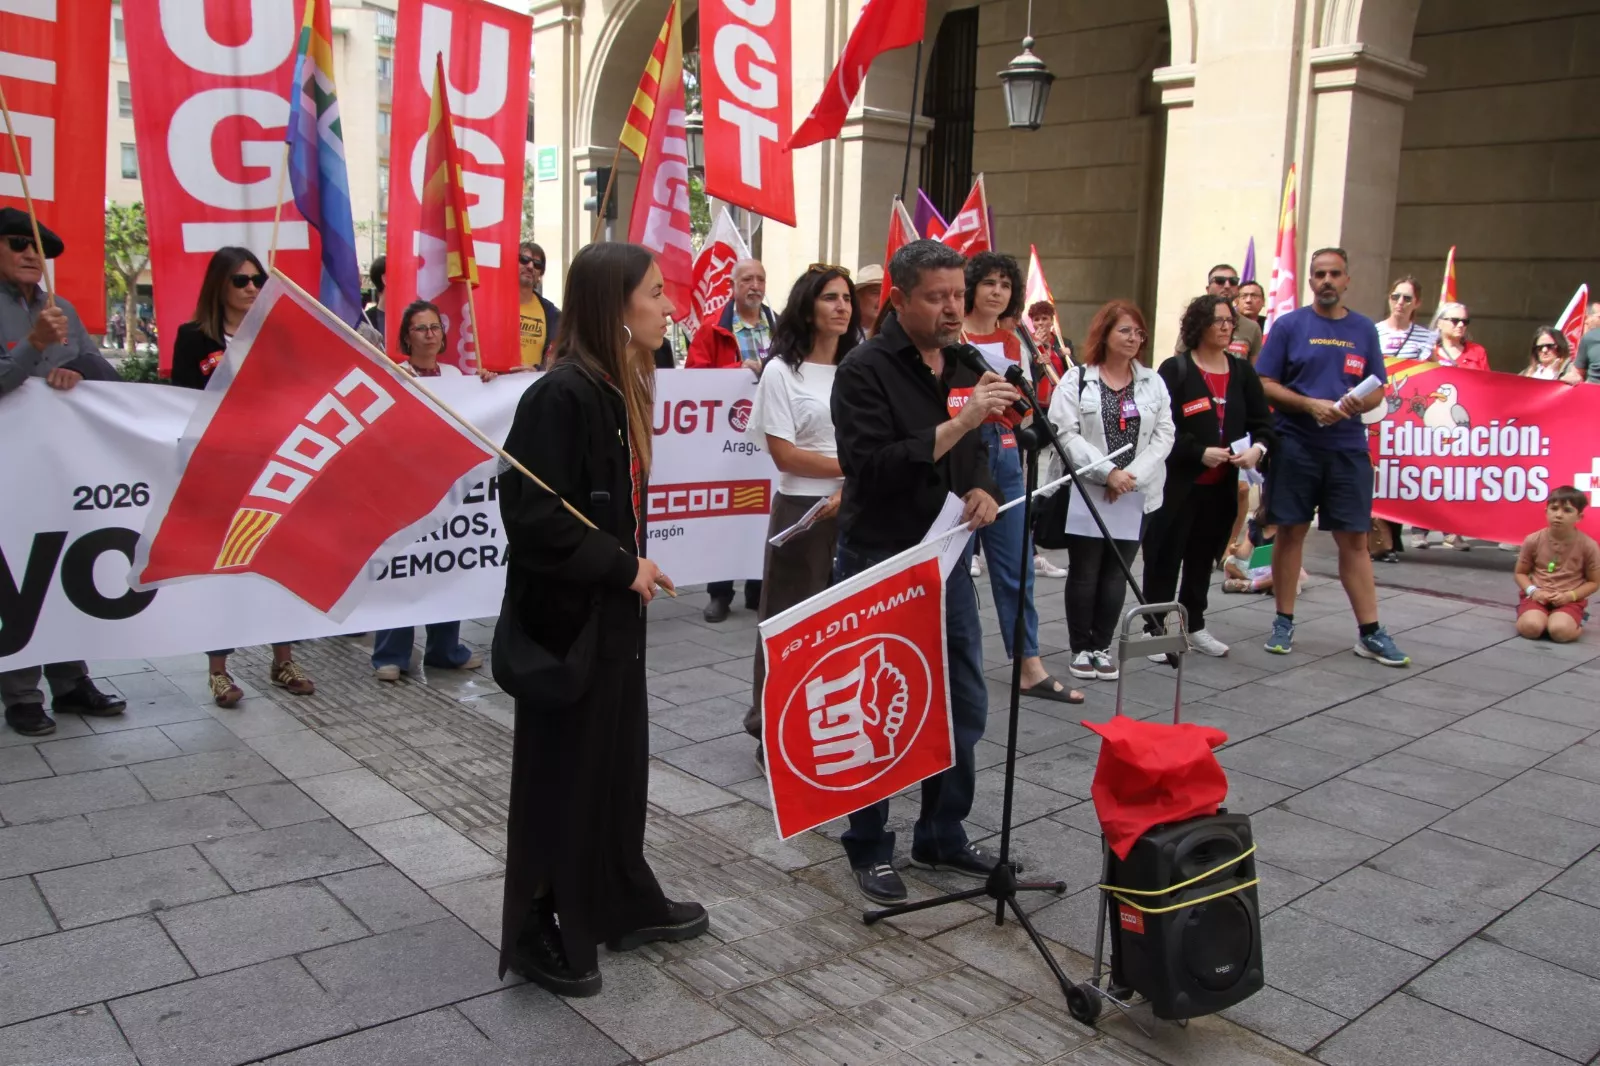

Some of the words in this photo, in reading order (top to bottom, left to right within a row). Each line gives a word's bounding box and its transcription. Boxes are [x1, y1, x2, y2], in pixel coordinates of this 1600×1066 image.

[652, 400, 722, 435] UGT
[948, 397, 962, 407] UGT
[250, 367, 396, 503] CCOO
[1379, 418, 1549, 457] Educación:
[73, 482, 150, 511] 2026
[1372, 459, 1549, 502] discursos
[648, 487, 729, 515] CCOO
